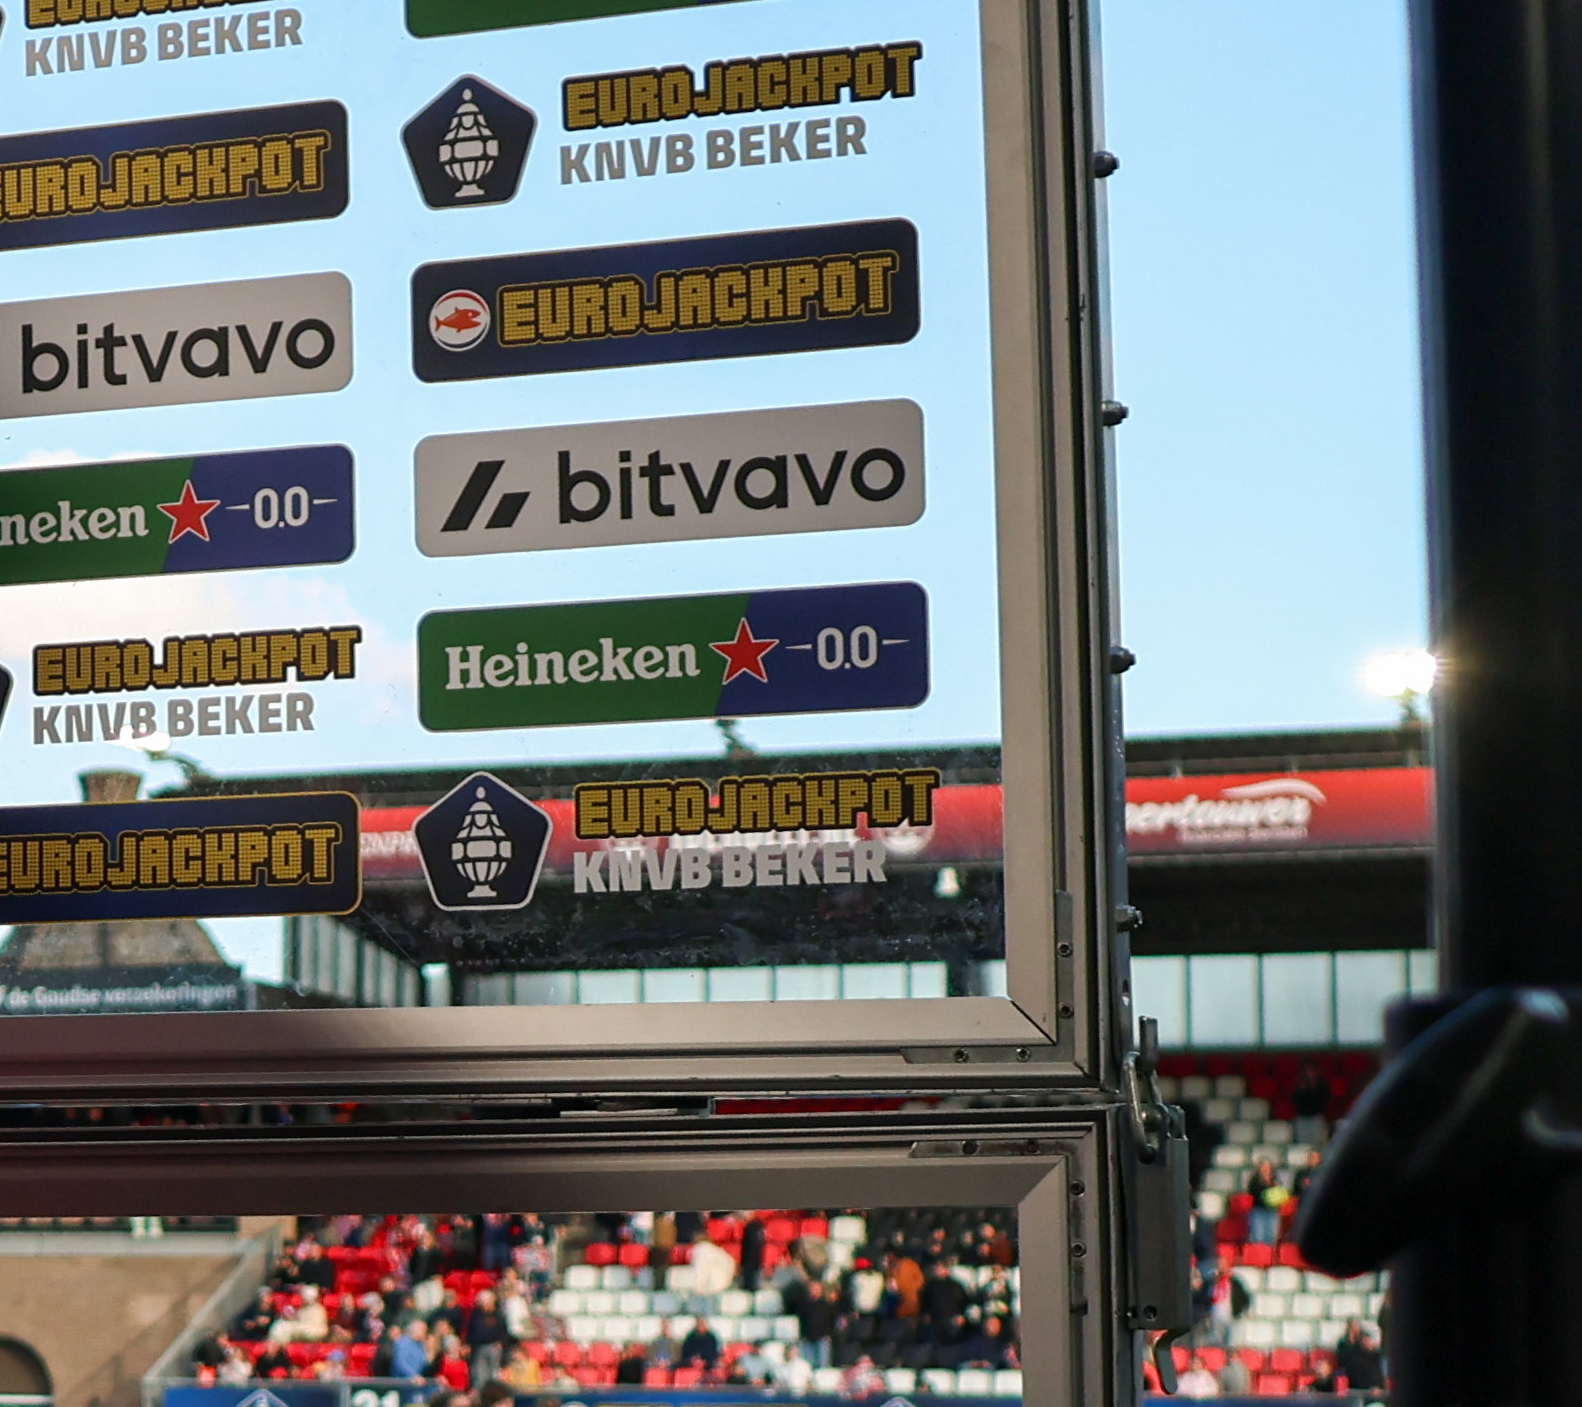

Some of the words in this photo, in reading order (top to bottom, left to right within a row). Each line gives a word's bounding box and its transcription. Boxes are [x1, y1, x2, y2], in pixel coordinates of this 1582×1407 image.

[25, 26, 147, 77] KNVB
[157, 7, 303, 61] BEKER
[562, 40, 922, 132] EUROJACKPOT
[559, 133, 696, 185] KNVB
[706, 114, 868, 171] BEKER
[498, 250, 899, 347] EUROJACKPOT
[21, 318, 336, 393] bitvavo
[253, 485, 310, 530] 0.0
[557, 447, 906, 524] bitvavo
[32, 625, 362, 696] EUROJACKPOT
[444, 637, 701, 691] Heineken
[816, 625, 879, 671] 0.0
[32, 699, 158, 745] KNVB
[168, 692, 316, 737] BEKER
[573, 768, 941, 840] EUROJACKPOT
[572, 848, 713, 894] KNVB
[721, 840, 889, 889] BEKER
